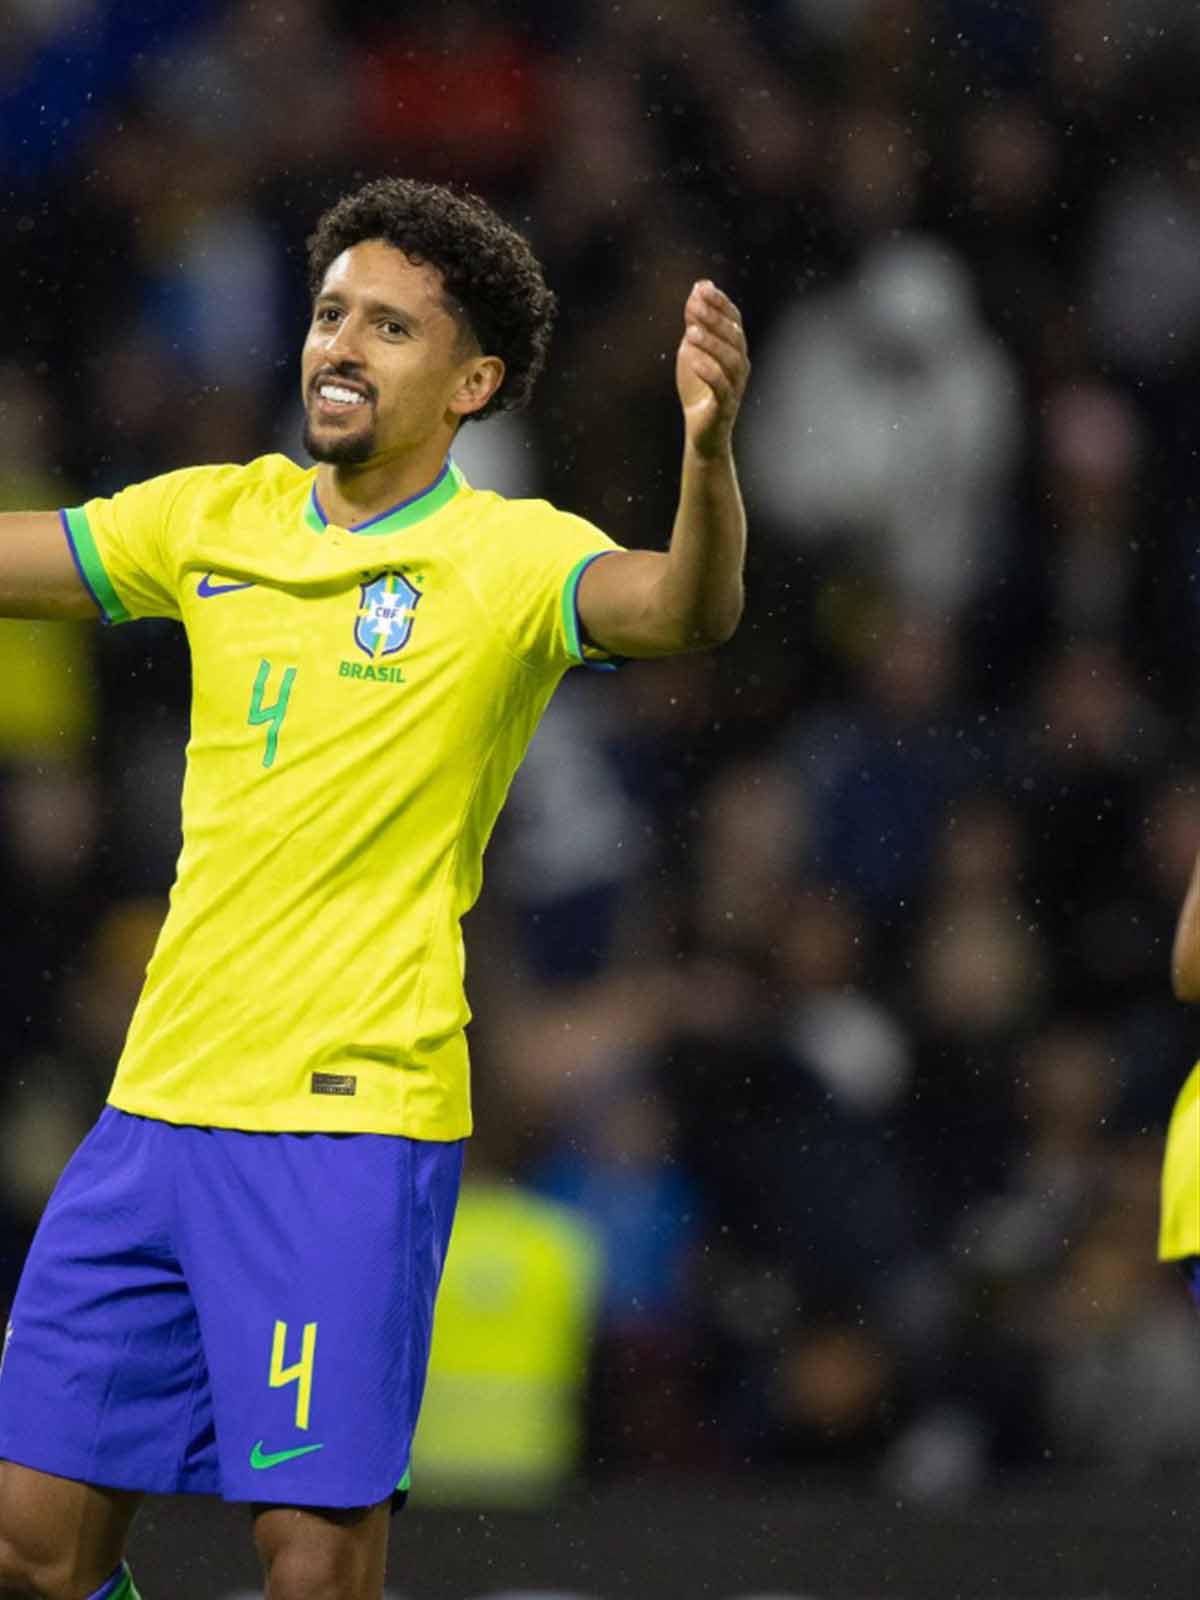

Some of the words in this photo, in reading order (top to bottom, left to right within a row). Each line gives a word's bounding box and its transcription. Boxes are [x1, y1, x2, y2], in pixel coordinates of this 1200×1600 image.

[247, 659, 297, 768] 4
[338, 661, 406, 683] BRASIL
[269, 1320, 317, 1430] 4
